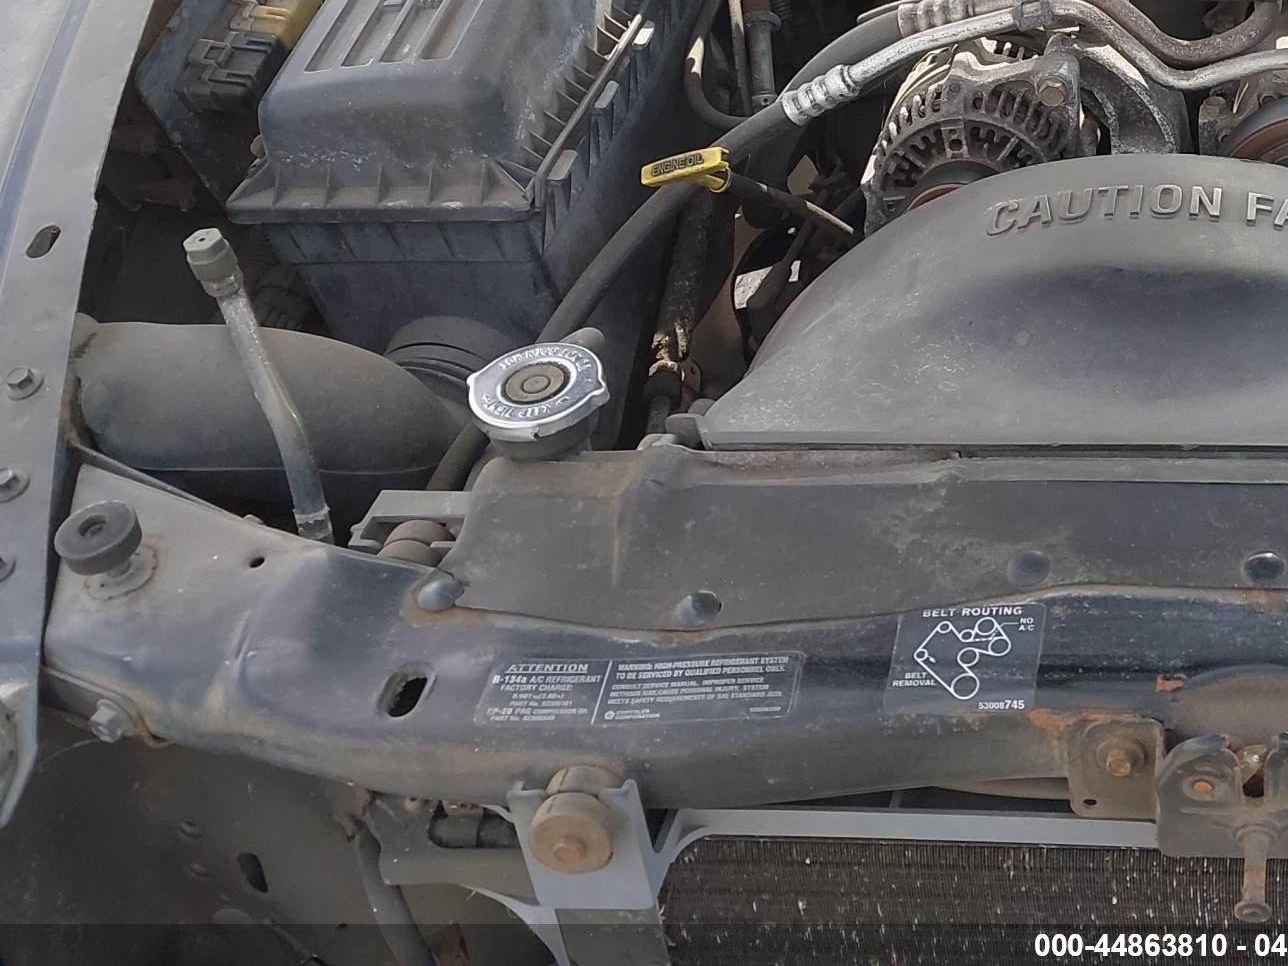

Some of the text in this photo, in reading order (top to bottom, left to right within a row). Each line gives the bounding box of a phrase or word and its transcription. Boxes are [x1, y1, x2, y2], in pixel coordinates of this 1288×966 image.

[652, 154, 704, 176] ENGINE OIL
[986, 184, 1222, 235] CAUTION
[923, 606, 1023, 618] BELT ROUTING
[760, 656, 789, 664] SYSTEM
[506, 664, 589, 673] ATTENTION
[529, 675, 545, 683] A/C
[545, 675, 602, 683] REFRIGERANT
[616, 672, 626, 680] TO
[638, 670, 672, 679] SERVICED
[685, 668, 721, 677] QUALIFIED
[892, 679, 936, 687] REMOVAL
[978, 700, 1025, 710] 53008745
